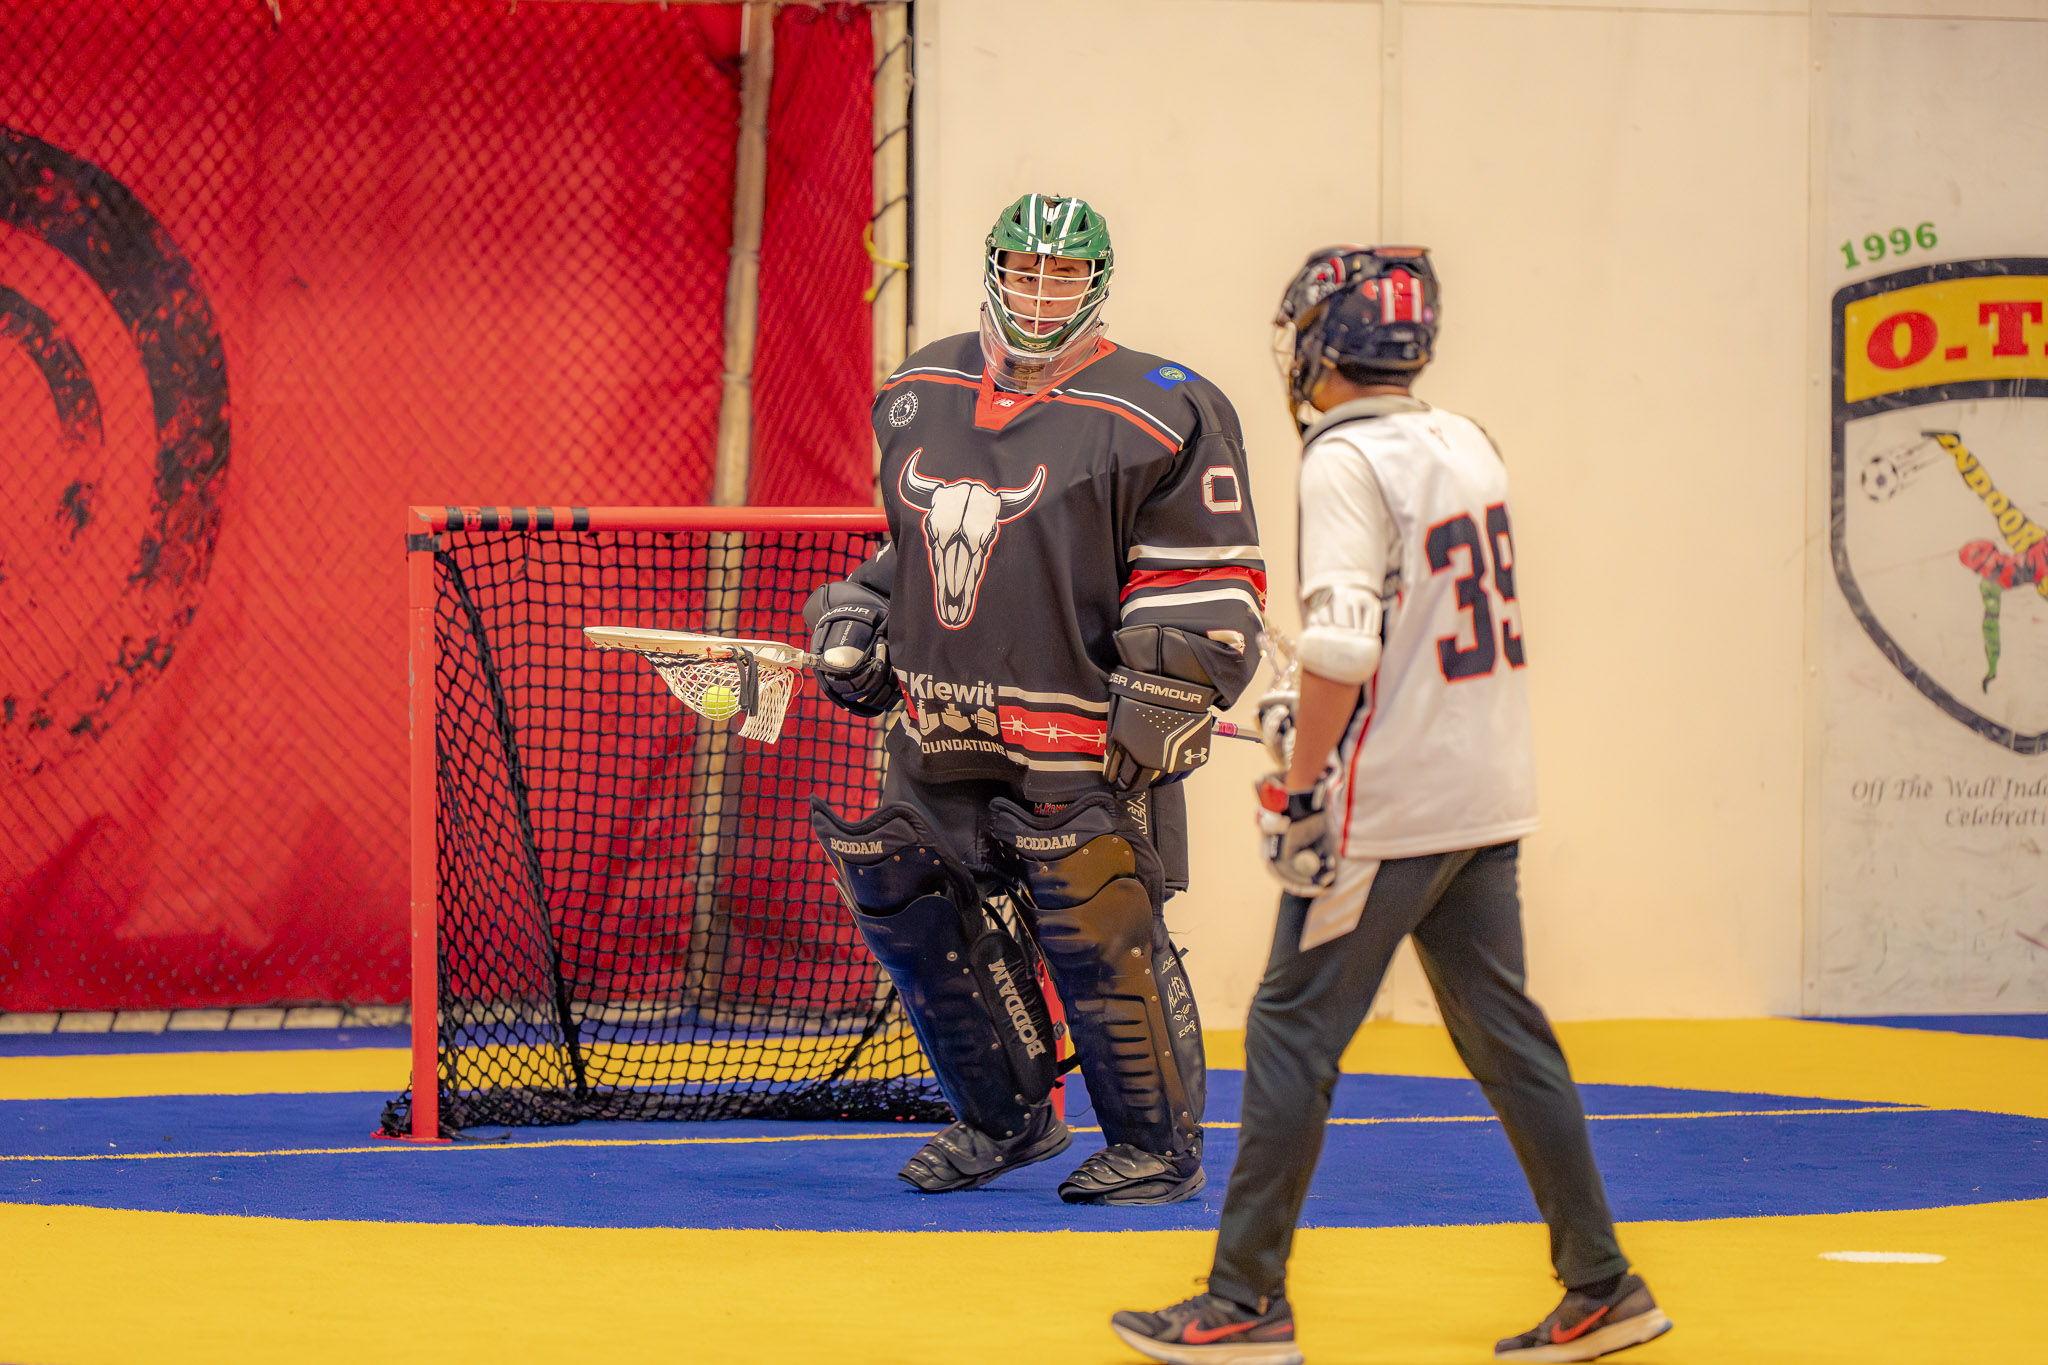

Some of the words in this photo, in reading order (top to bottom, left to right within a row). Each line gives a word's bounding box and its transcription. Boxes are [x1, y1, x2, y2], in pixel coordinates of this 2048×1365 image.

[1840, 222, 1938, 270] 1996
[1866, 301, 2048, 371] O.T
[1425, 502, 1527, 683] 39
[910, 671, 995, 707] Kiewit
[1130, 680, 1203, 704] ARMOUR
[921, 739, 1007, 756] OUNDATIONS
[1851, 776, 1887, 808] Off
[1894, 774, 1933, 800] The
[1944, 775, 1999, 799] Wall
[830, 837, 883, 855] BODDAM
[1015, 833, 1077, 851] BODDAM
[988, 958, 1047, 1060] BODDAM
